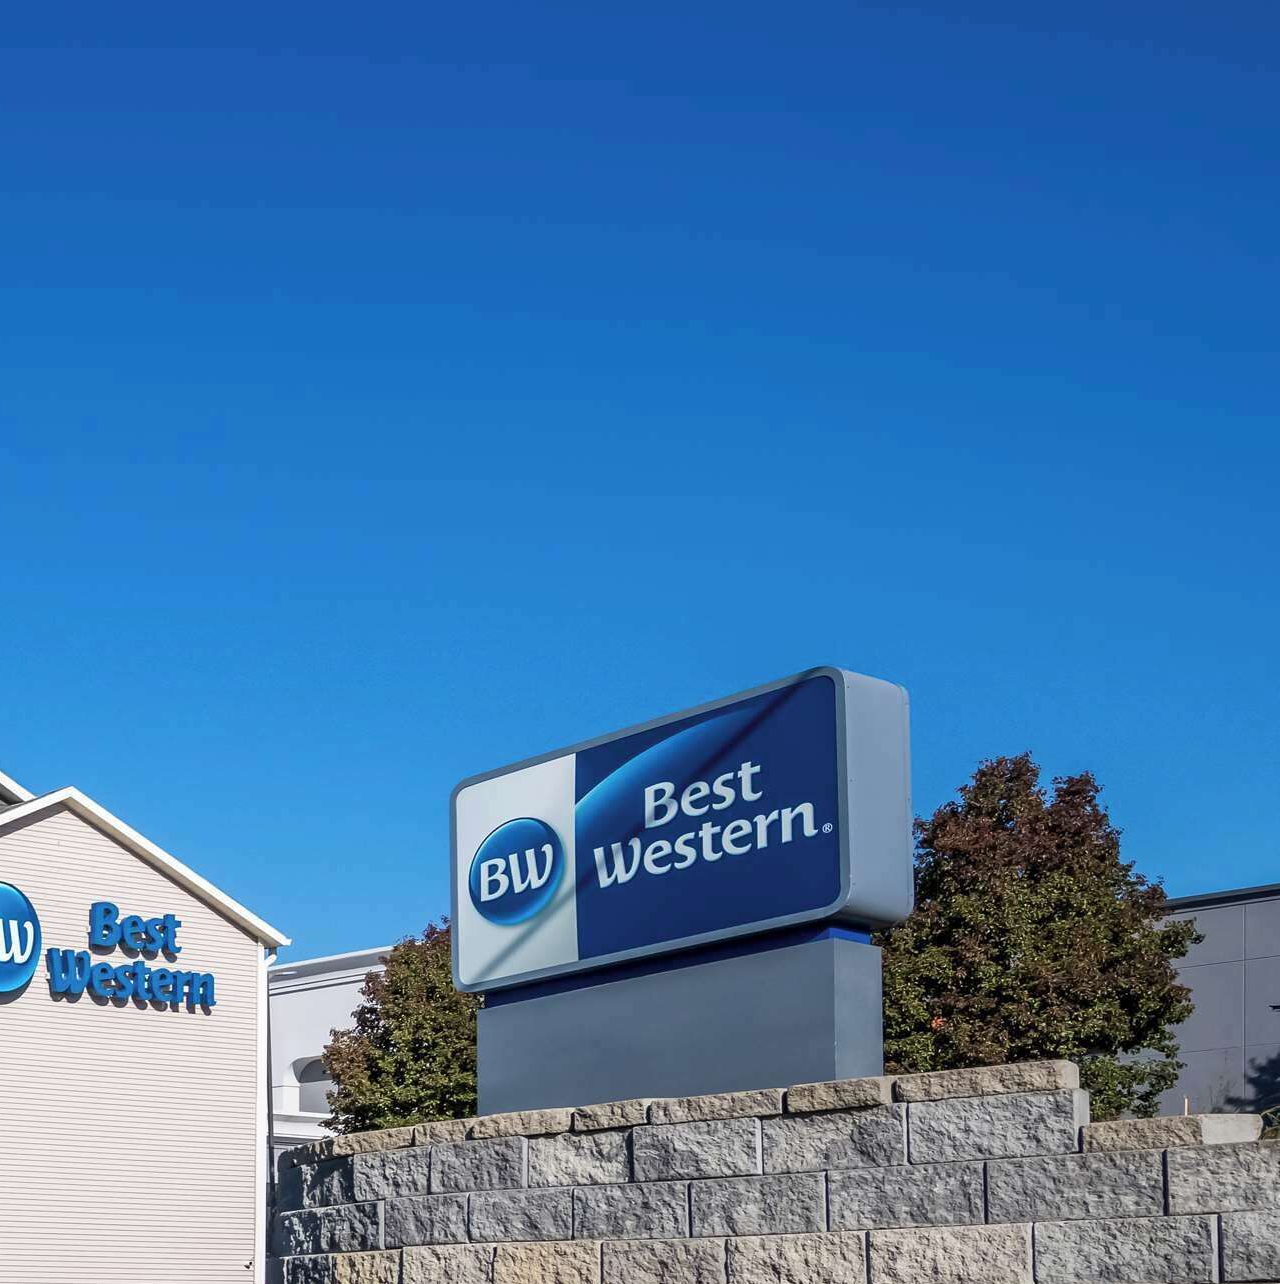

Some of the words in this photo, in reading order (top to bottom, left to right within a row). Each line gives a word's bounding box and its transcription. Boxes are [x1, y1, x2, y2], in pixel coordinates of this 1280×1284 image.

[643, 761, 763, 829] Best
[479, 842, 554, 902] BW
[88, 901, 183, 954] Best
[45, 946, 217, 1008] Western
